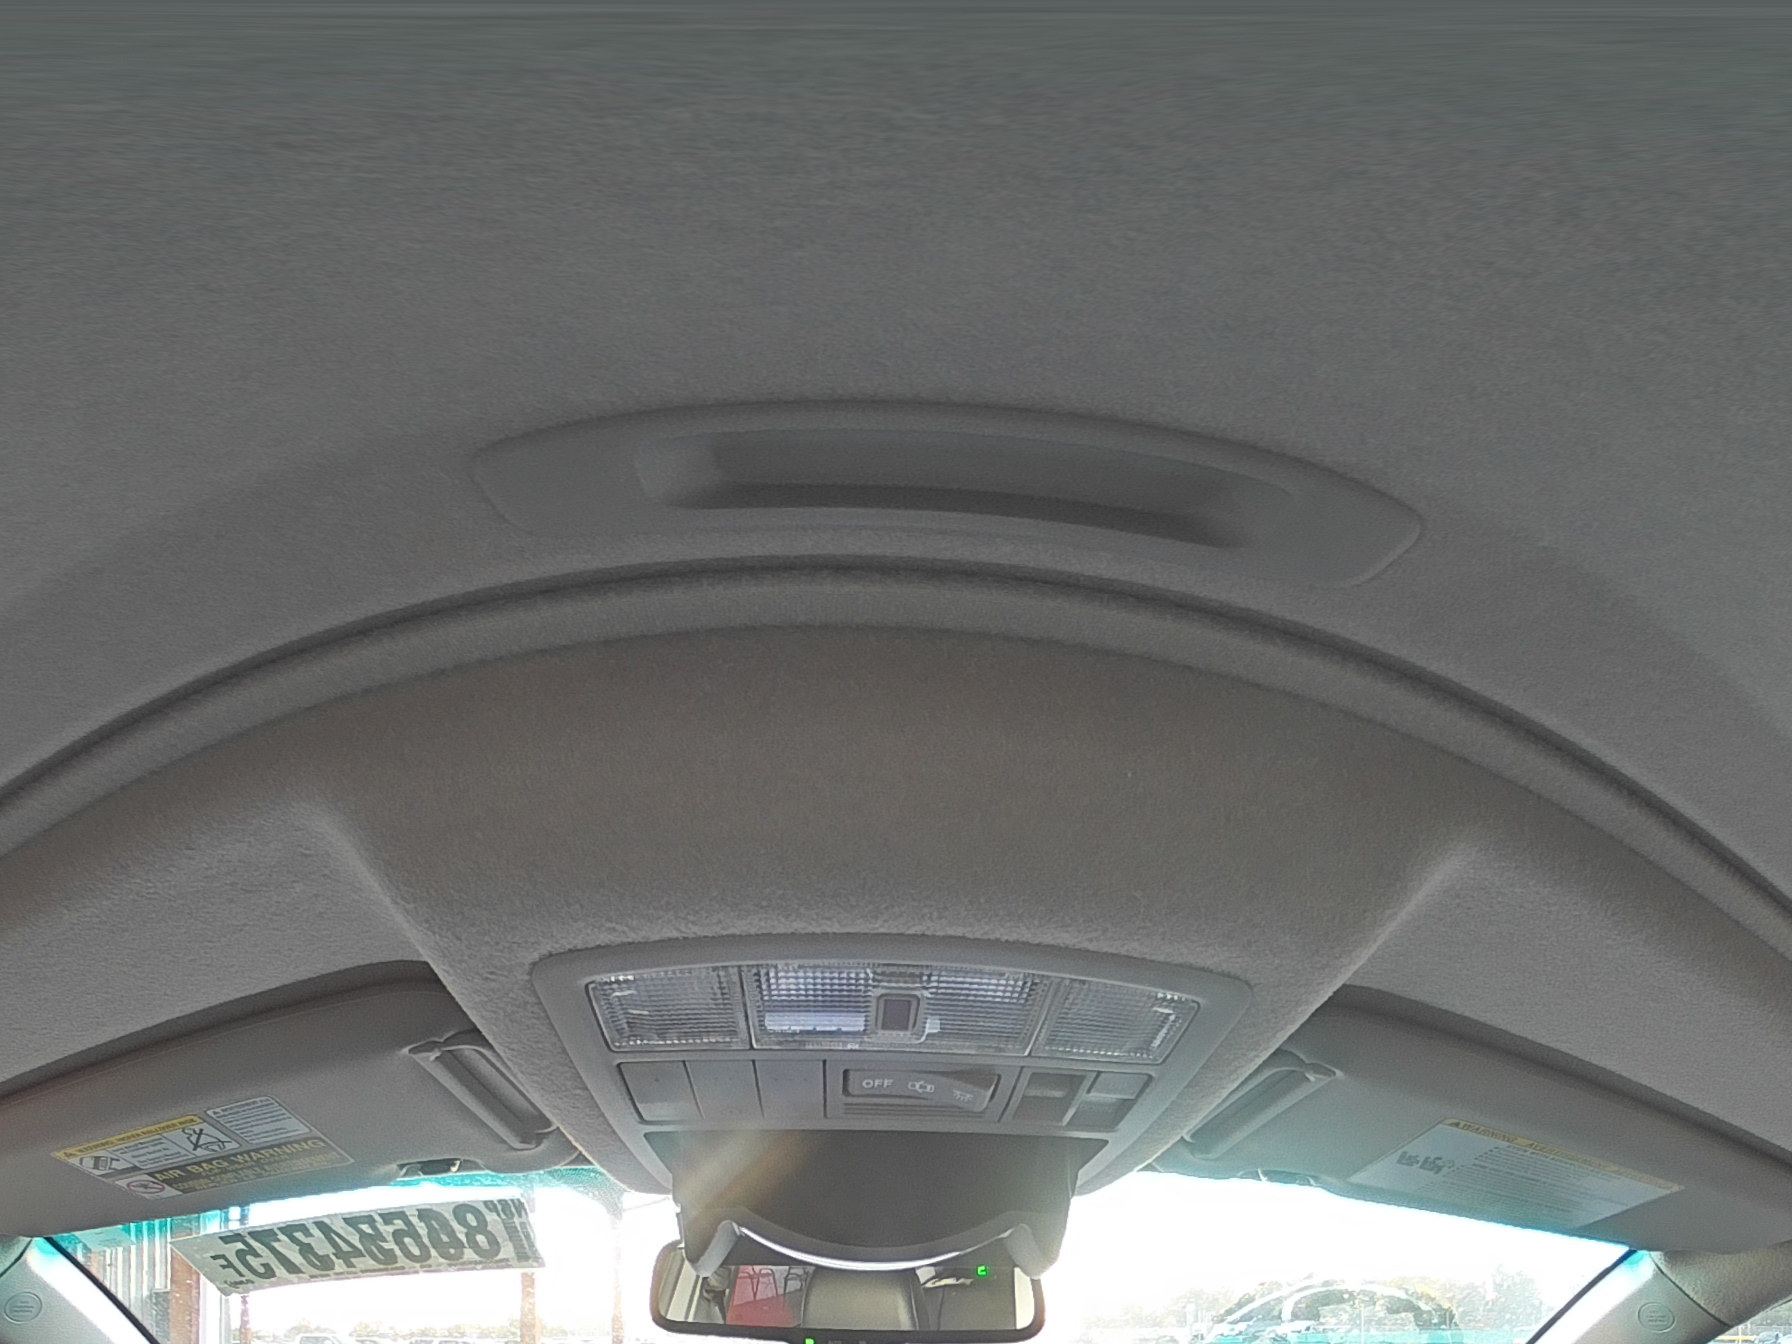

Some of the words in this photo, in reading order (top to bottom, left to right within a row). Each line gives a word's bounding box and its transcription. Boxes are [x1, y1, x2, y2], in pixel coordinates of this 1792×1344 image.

[862, 1078, 894, 1089] OFF
[155, 1168, 185, 1182] AIR
[186, 1159, 229, 1174] BAG
[231, 1140, 327, 1164] WARNING
